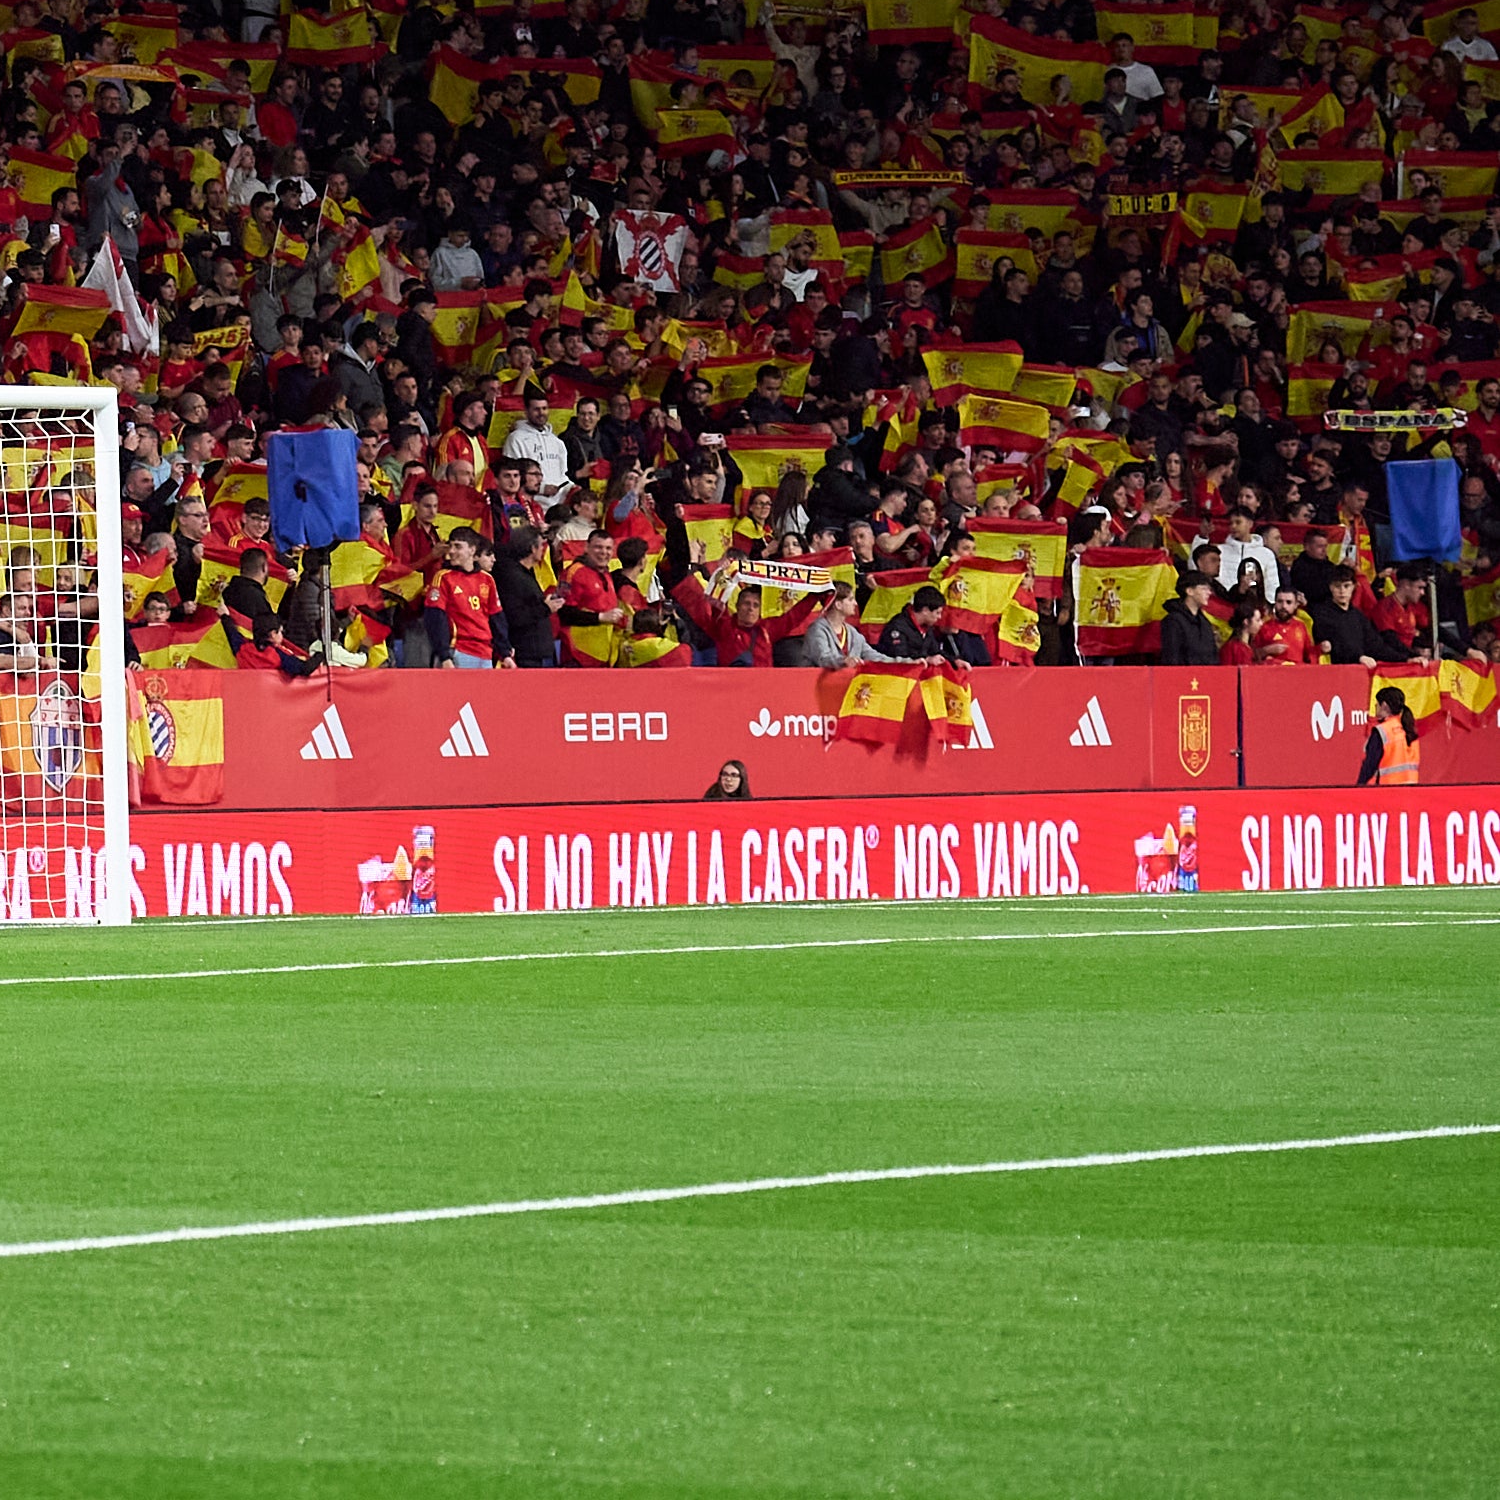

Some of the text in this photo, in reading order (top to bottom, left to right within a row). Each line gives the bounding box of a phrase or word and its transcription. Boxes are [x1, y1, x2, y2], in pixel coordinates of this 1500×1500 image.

[766, 563, 815, 583] PRAT
[469, 595, 481, 611] 19
[563, 711, 668, 742] EBRO
[1240, 814, 1271, 891] SI
[1283, 814, 1323, 890] NO
[1335, 812, 1388, 888] HAY
[1399, 811, 1435, 886] LA
[493, 836, 530, 912] SI
[544, 834, 593, 911] NO
[608, 831, 674, 908] HAY
[687, 829, 727, 905] LA
[894, 823, 961, 900] NOS
